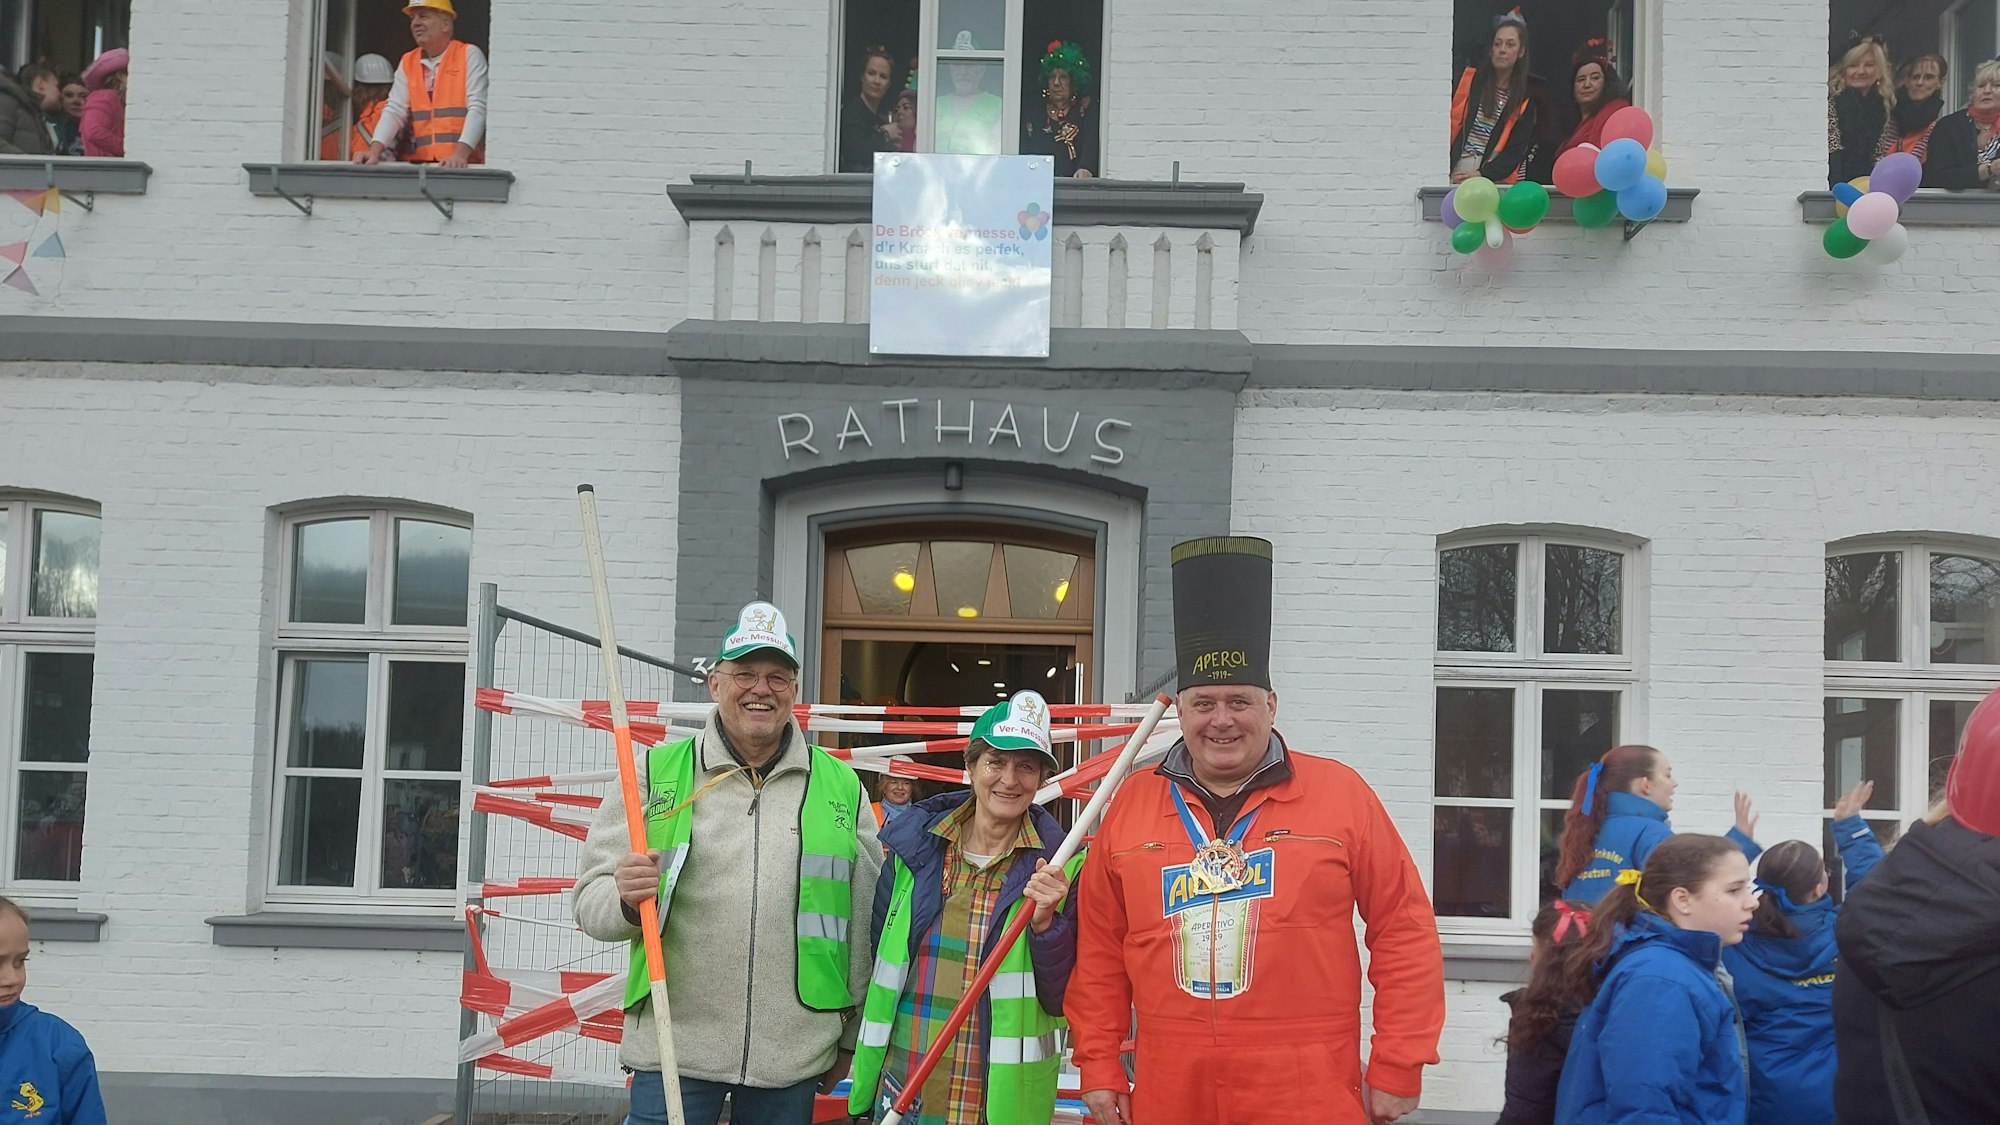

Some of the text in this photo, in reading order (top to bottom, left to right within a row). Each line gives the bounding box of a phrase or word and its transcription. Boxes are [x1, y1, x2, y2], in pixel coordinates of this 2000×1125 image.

[876, 224, 895, 237] De
[875, 241, 895, 253] d'r
[976, 242, 1024, 257] perfek,
[914, 276, 944, 290] jeck
[777, 398, 1132, 464] RATHAUS
[730, 633, 789, 650] Ver- Messung
[1192, 650, 1249, 675] APEROL
[998, 724, 1019, 733] Ver-
[1191, 918, 1235, 932] APERTIVO
